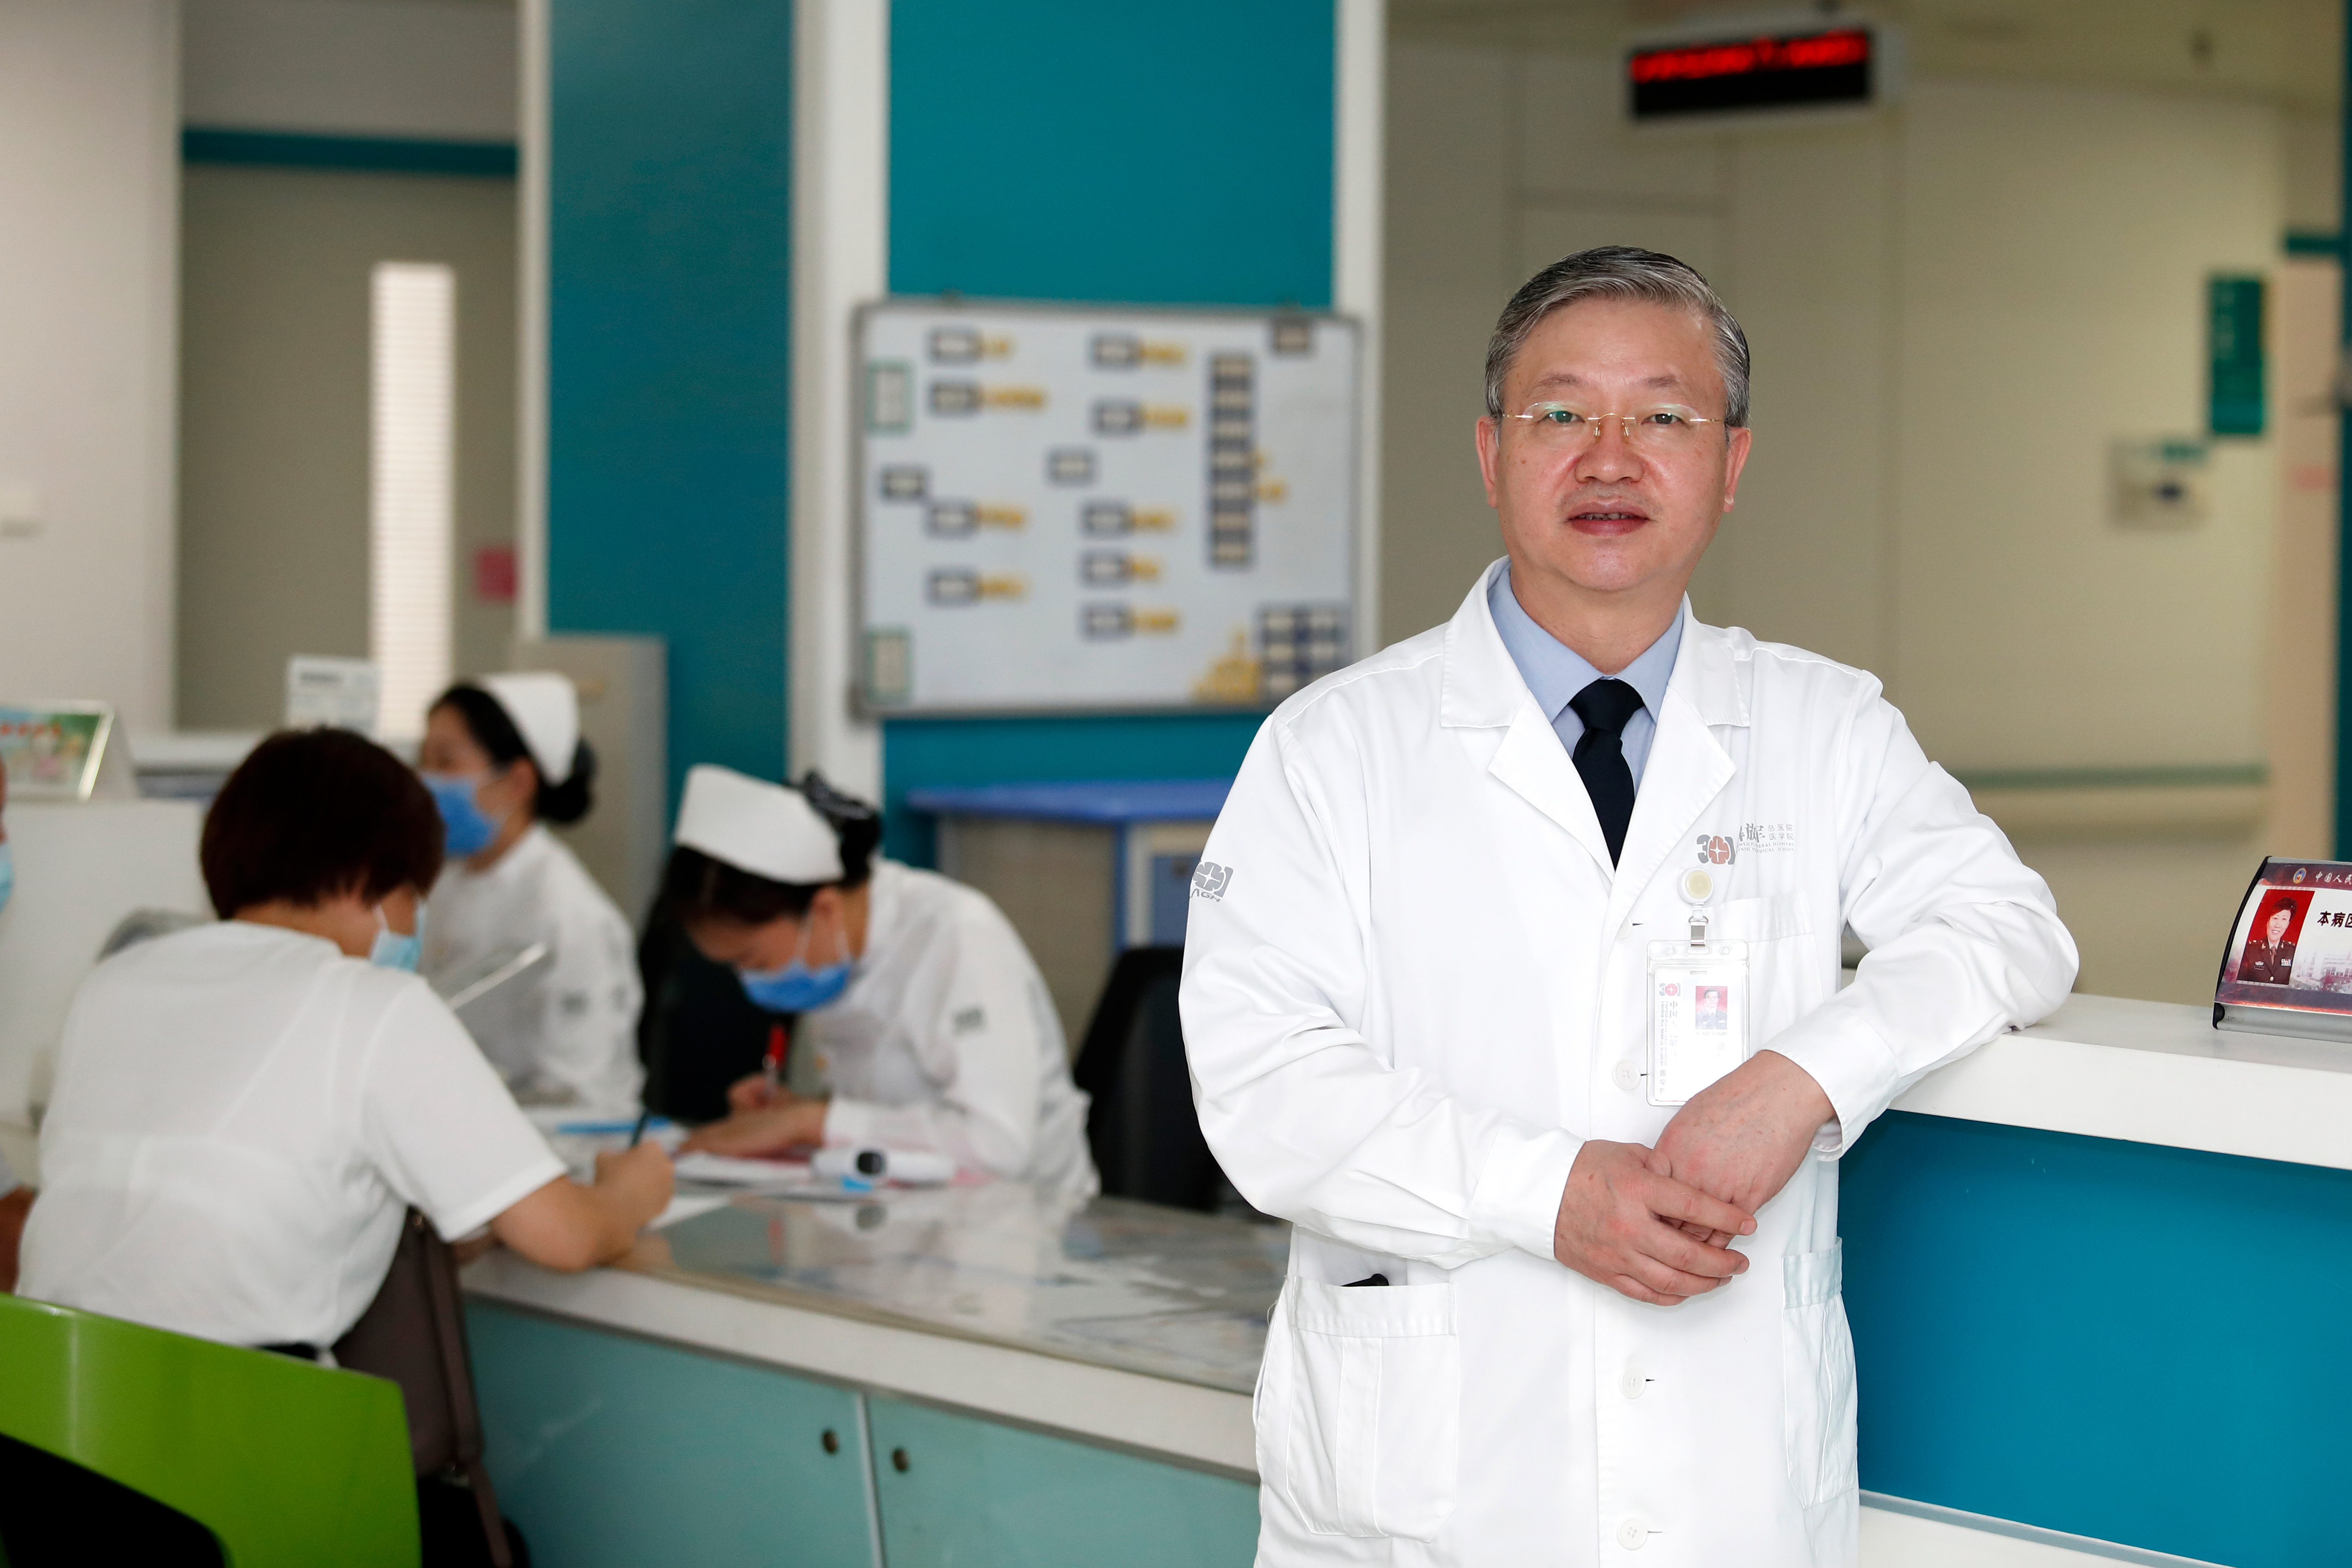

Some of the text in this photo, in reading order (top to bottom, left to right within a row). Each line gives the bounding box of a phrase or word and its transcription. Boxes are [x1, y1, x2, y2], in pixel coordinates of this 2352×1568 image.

[1768, 824, 1793, 832] 总医院
[1697, 834, 1736, 865] 301
[1193, 861, 1234, 898] 01
